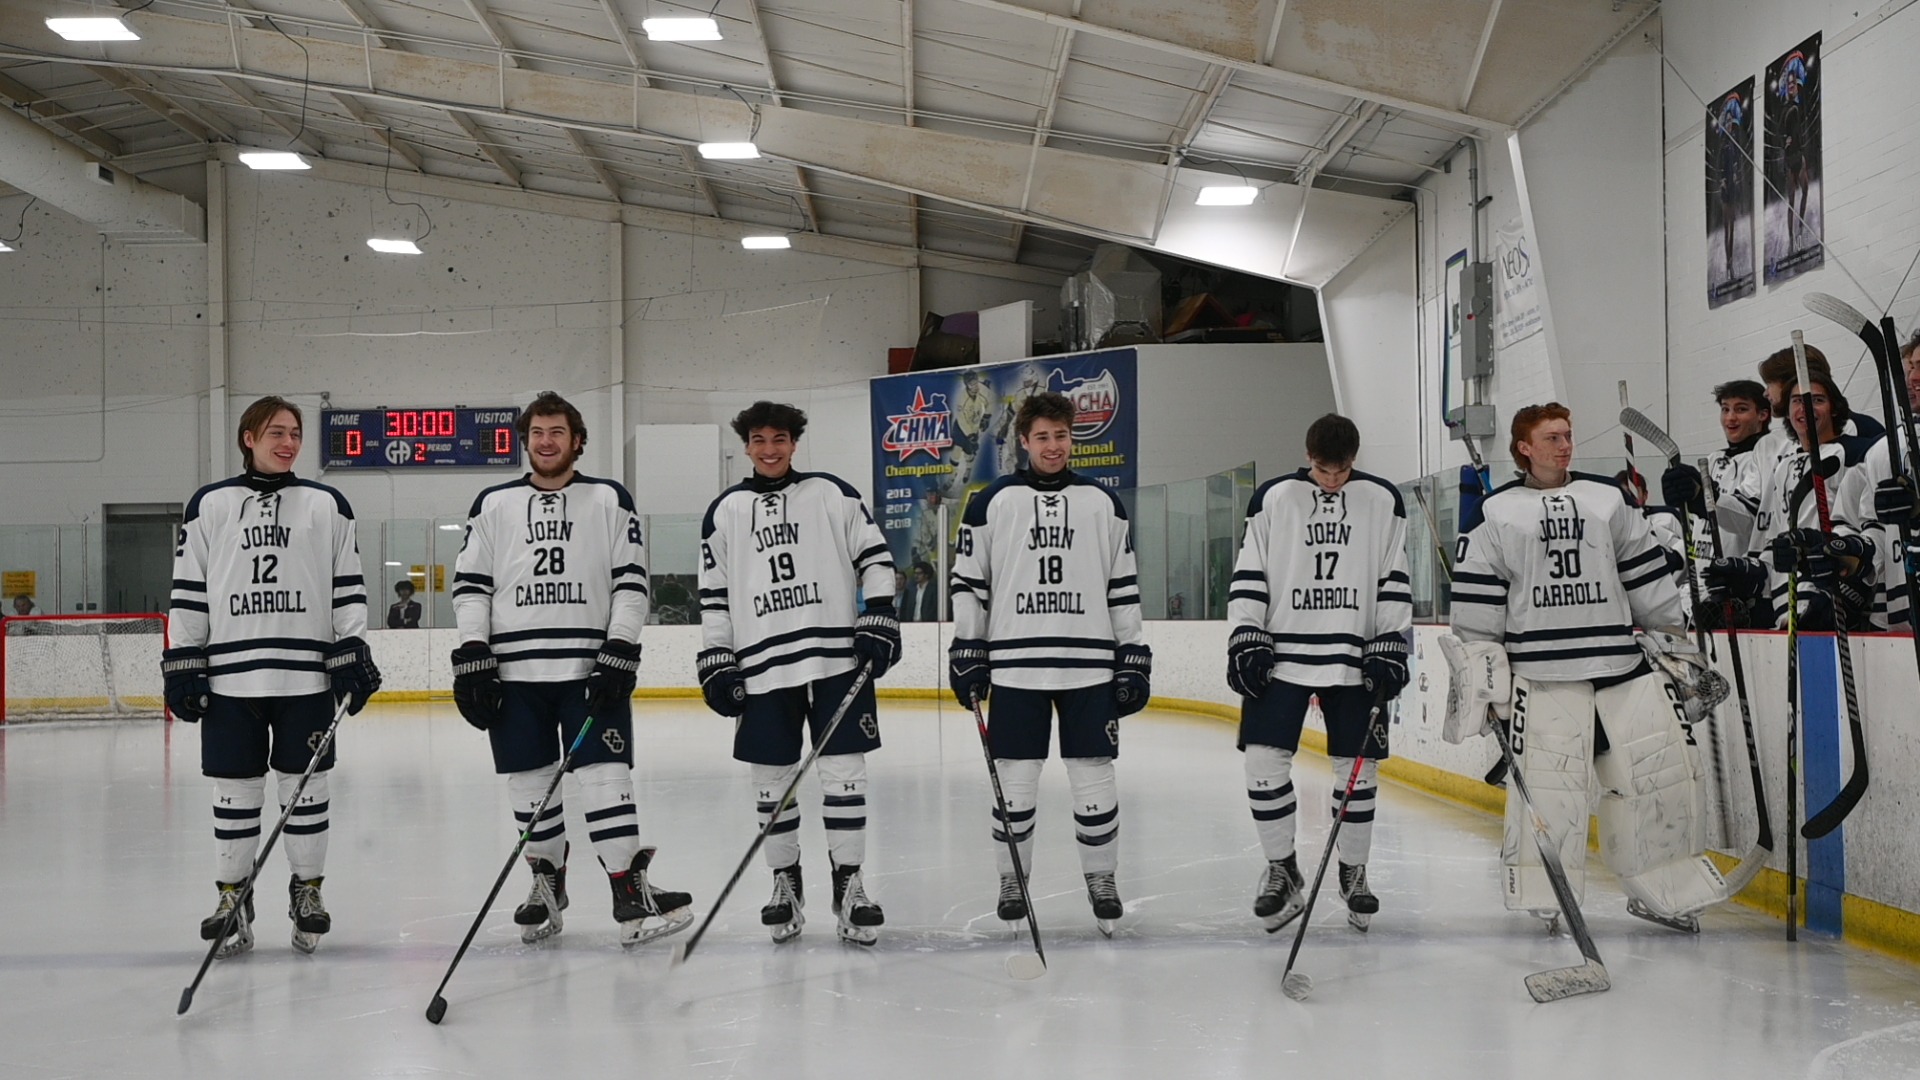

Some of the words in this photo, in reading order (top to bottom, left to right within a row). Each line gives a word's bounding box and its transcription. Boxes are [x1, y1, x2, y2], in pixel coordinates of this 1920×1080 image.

[330, 414, 360, 426] HOME
[386, 411, 454, 436] 30:00
[474, 412, 513, 424] VISITOR
[895, 414, 949, 443] CHMA
[346, 430, 361, 455] 0
[415, 443, 426, 461] 2
[427, 443, 452, 452] PERIOD
[495, 429, 510, 453] 0
[1071, 441, 1114, 455] tional
[885, 463, 954, 478] Champions
[1067, 454, 1125, 468] rnament
[885, 488, 912, 499] 2013
[1095, 476, 1120, 487] 013
[885, 503, 911, 514] 2017
[525, 520, 574, 544] JOHN
[885, 518, 912, 529] 2018
[1305, 522, 1352, 546] JOHN
[1540, 517, 1586, 543] JOHN
[241, 524, 291, 550] JOHN
[755, 522, 800, 553] JOHN
[956, 527, 974, 557] 18
[1028, 526, 1075, 551] JOHN
[251, 554, 279, 584] 12
[533, 547, 565, 576] 28
[768, 552, 796, 584] 19
[1038, 555, 1063, 585] 18
[1314, 551, 1340, 580] 17
[1548, 549, 1581, 579] 30
[230, 590, 307, 616] CARROLL
[515, 582, 587, 607] CARROLL
[753, 582, 823, 617] CARROLL
[1016, 592, 1085, 615] CARROLL
[1292, 587, 1359, 611] CARROLL
[1532, 581, 1608, 608] CARROLL
[855, 615, 900, 631] ARRIOR
[164, 658, 208, 672] WARRIO
[1512, 687, 1528, 756] CCM
[1664, 682, 1698, 746] CCM
[1739, 698, 1758, 768] CCM
